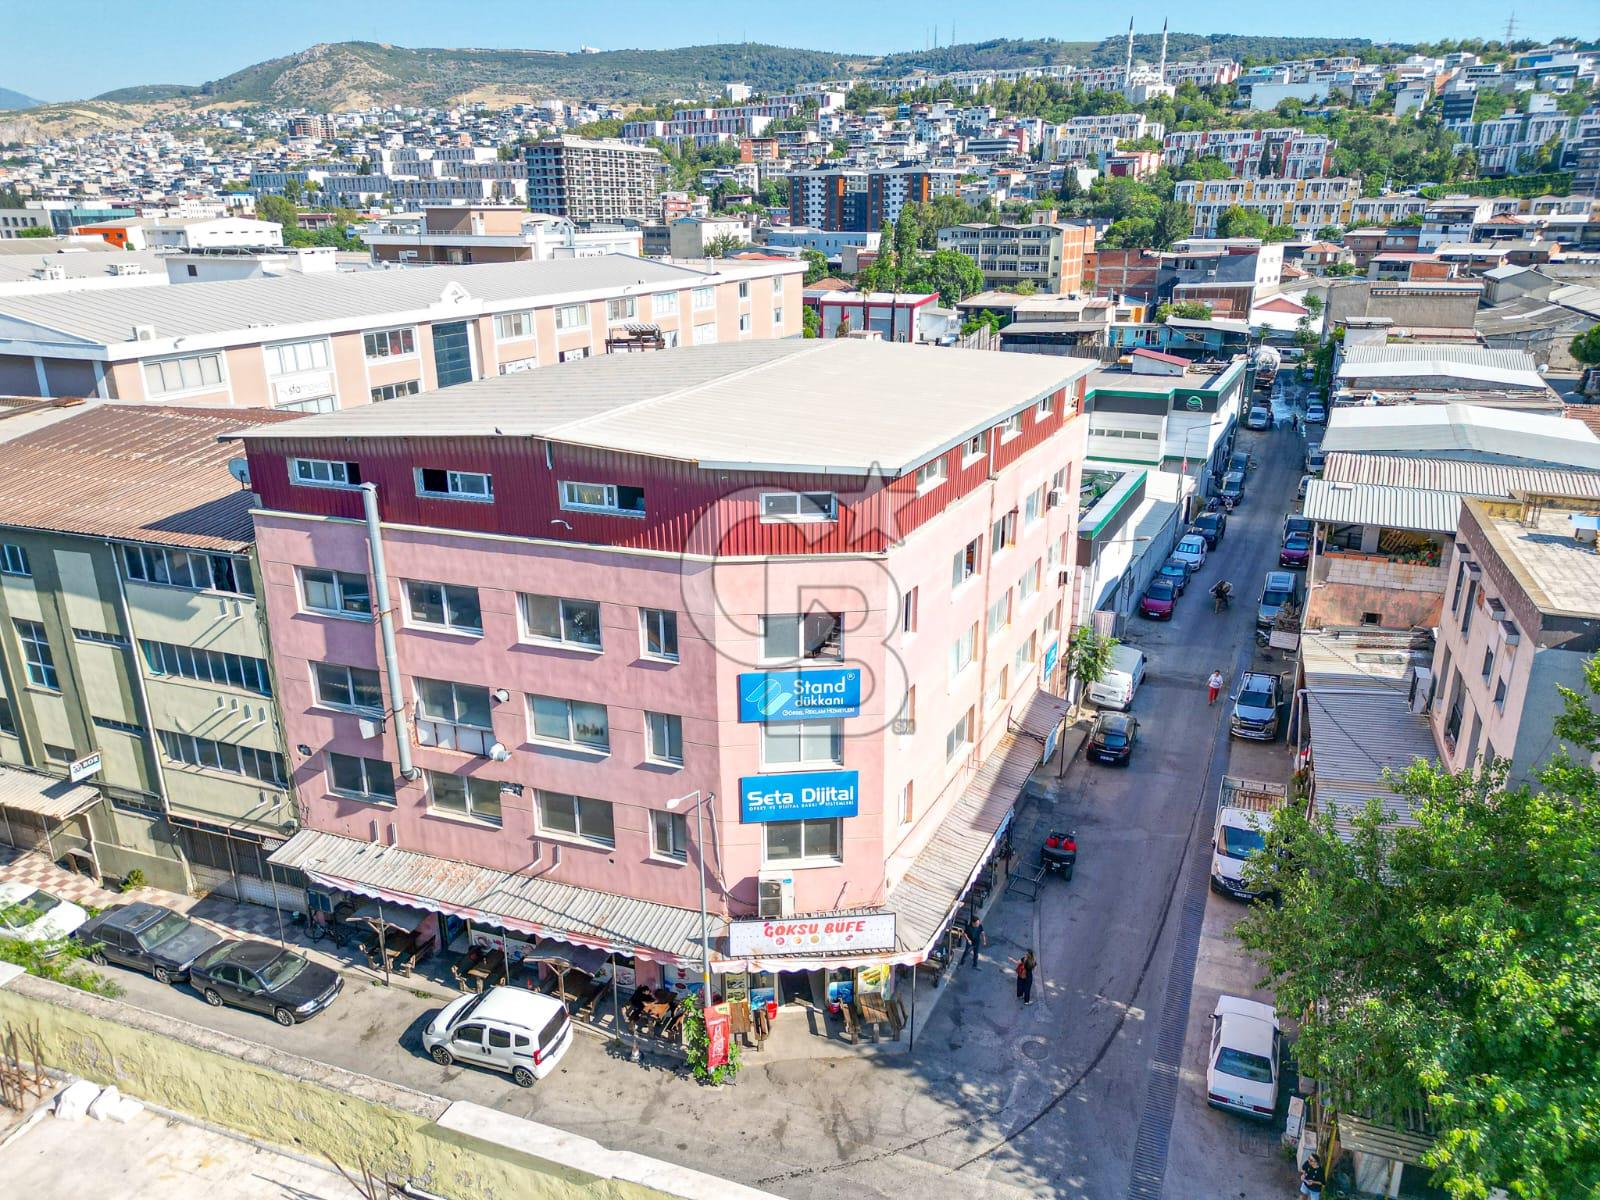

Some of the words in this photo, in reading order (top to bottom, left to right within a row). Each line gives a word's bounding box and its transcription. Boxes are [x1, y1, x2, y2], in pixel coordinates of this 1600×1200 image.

[793, 676, 846, 696] Stand
[795, 694, 844, 707] dükkanı
[747, 789, 794, 807] Seta
[801, 785, 854, 804] Dijital
[764, 921, 818, 938] GÖKSU
[824, 919, 866, 934] BÜFE
